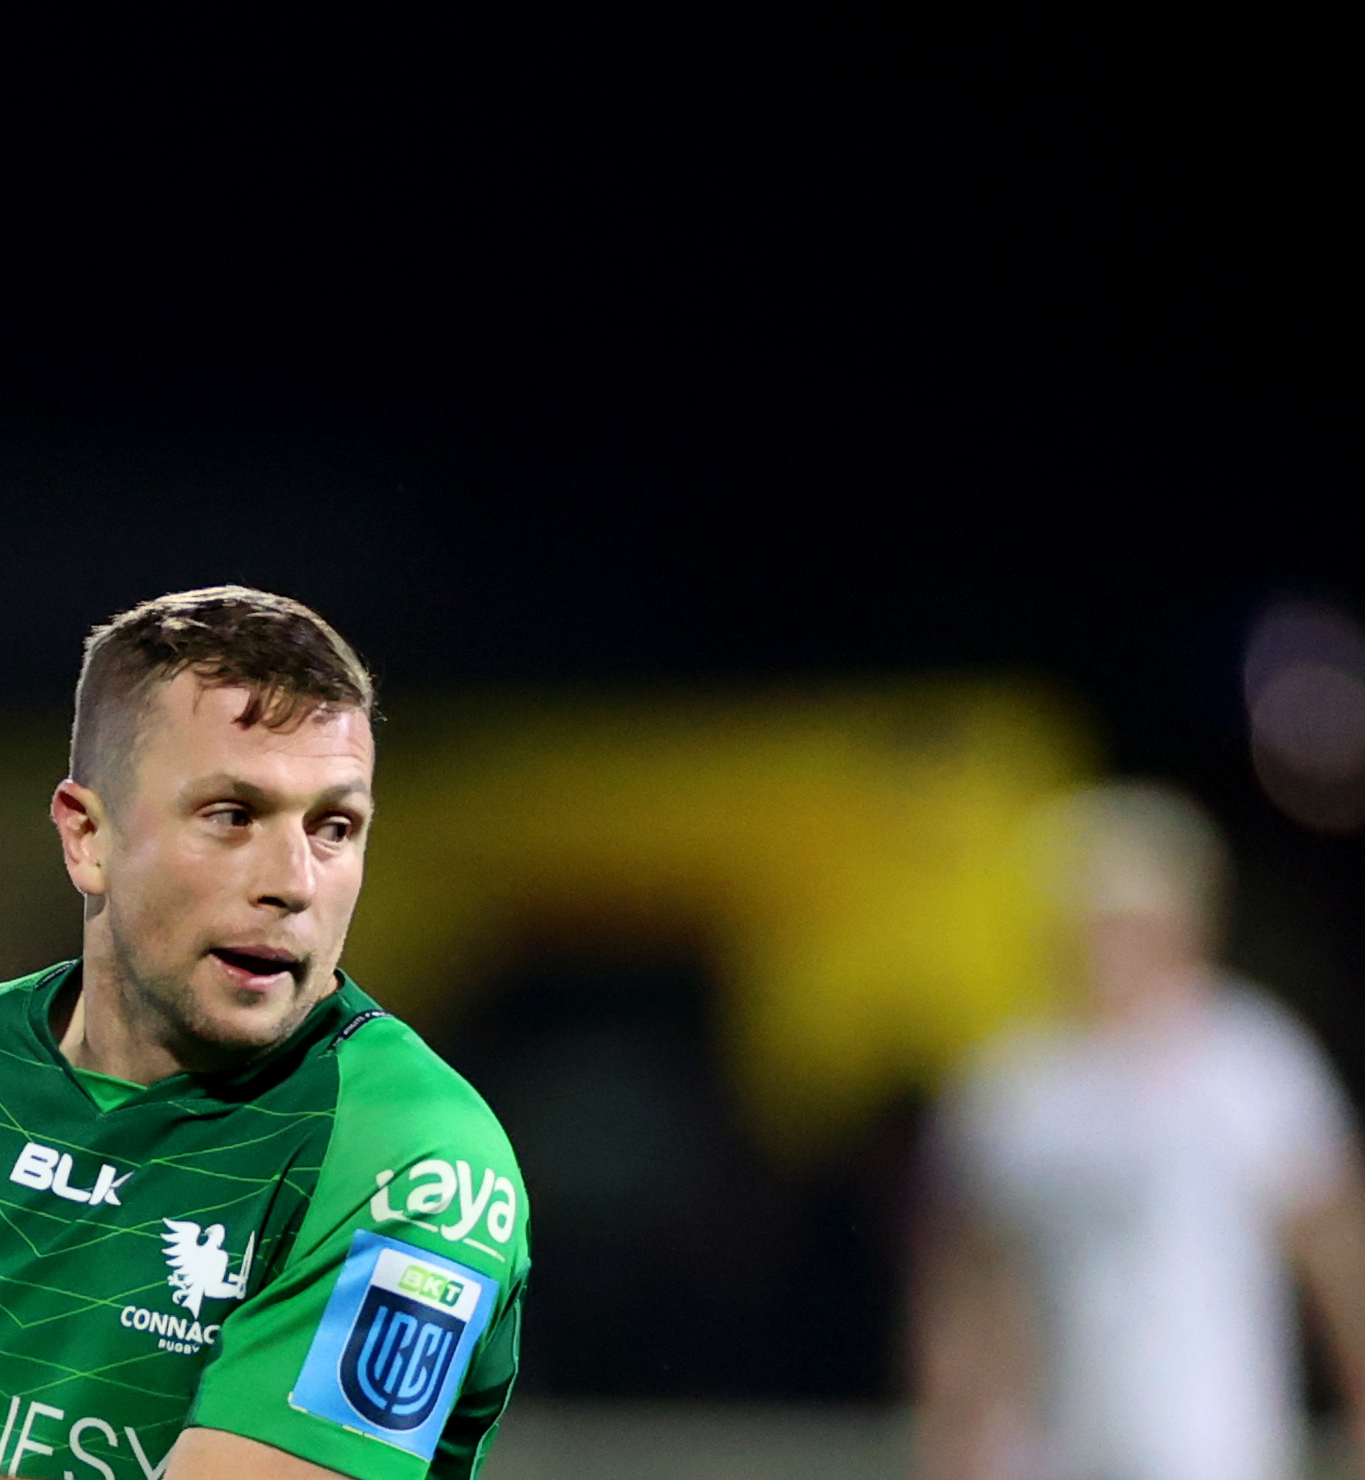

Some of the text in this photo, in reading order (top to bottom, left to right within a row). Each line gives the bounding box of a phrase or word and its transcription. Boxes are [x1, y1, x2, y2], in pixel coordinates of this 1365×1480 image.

[9, 1142, 135, 1206] BLK
[398, 1265, 464, 1306] BKT
[120, 1305, 221, 1345] CONNAC
[157, 1338, 201, 1355] RUGBY
